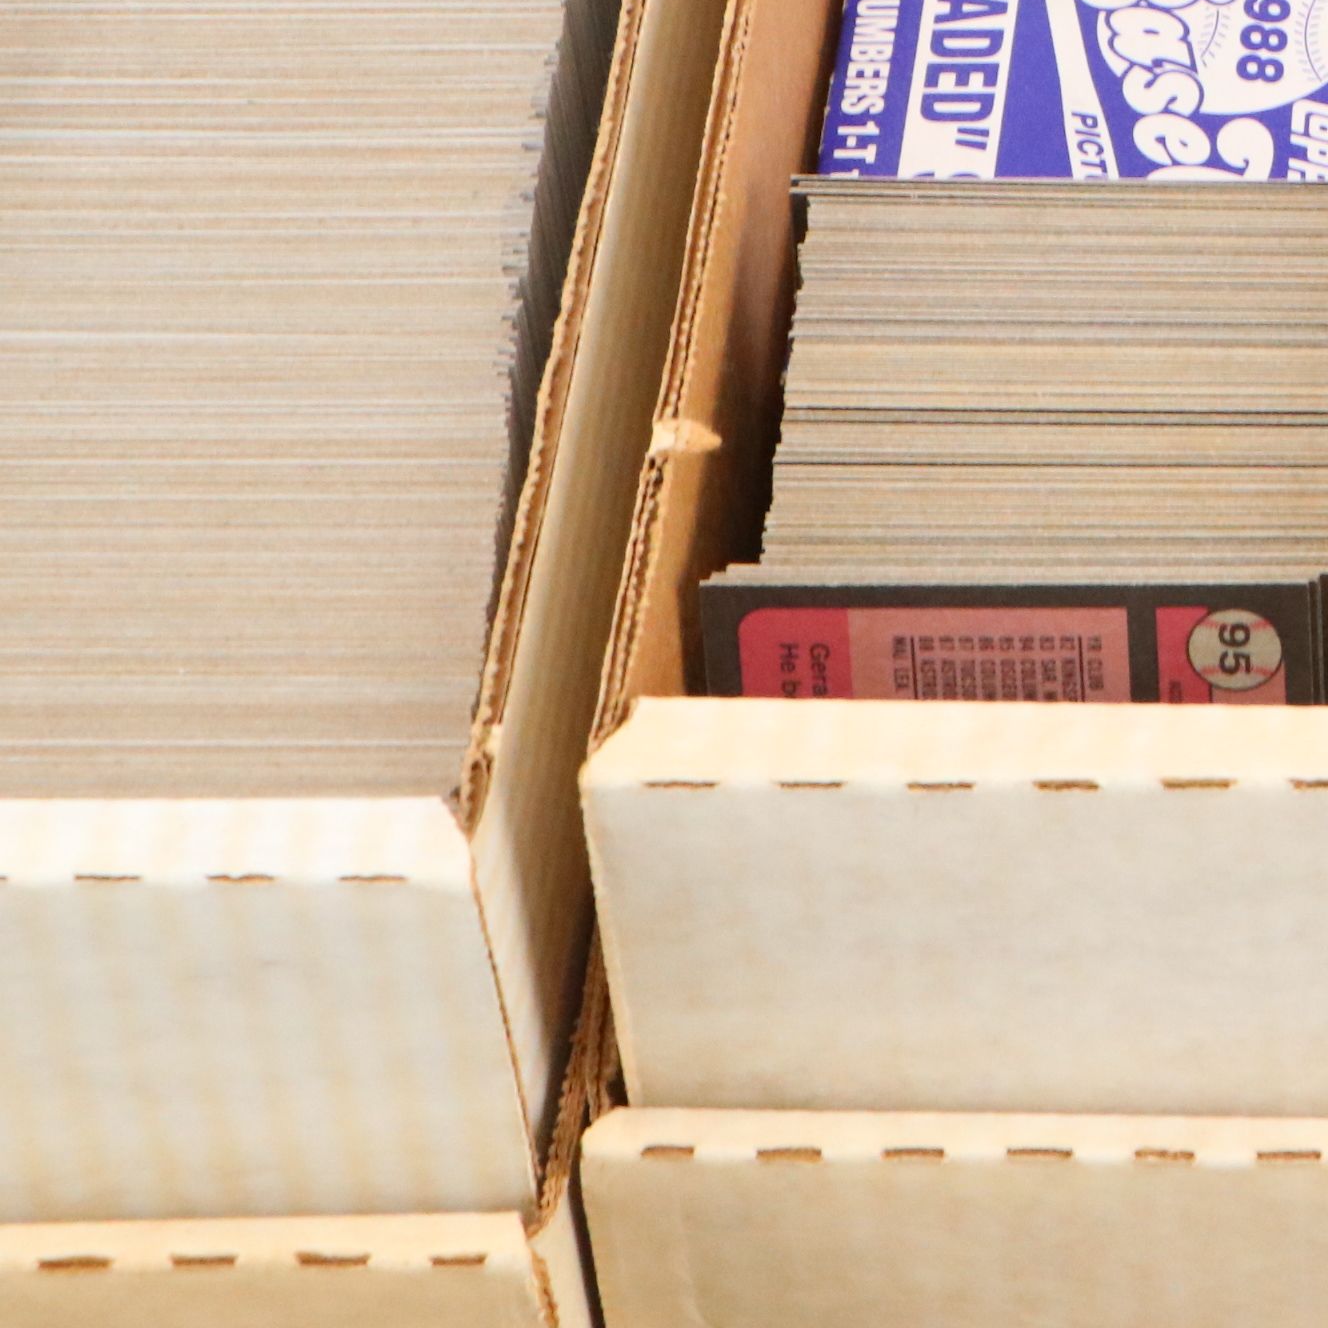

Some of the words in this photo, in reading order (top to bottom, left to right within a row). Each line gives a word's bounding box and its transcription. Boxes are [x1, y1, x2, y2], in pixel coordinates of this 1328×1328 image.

[833, 120, 880, 164] 1-T
[1071, 111, 1109, 179] PICT
[1218, 622, 1251, 675] 95
